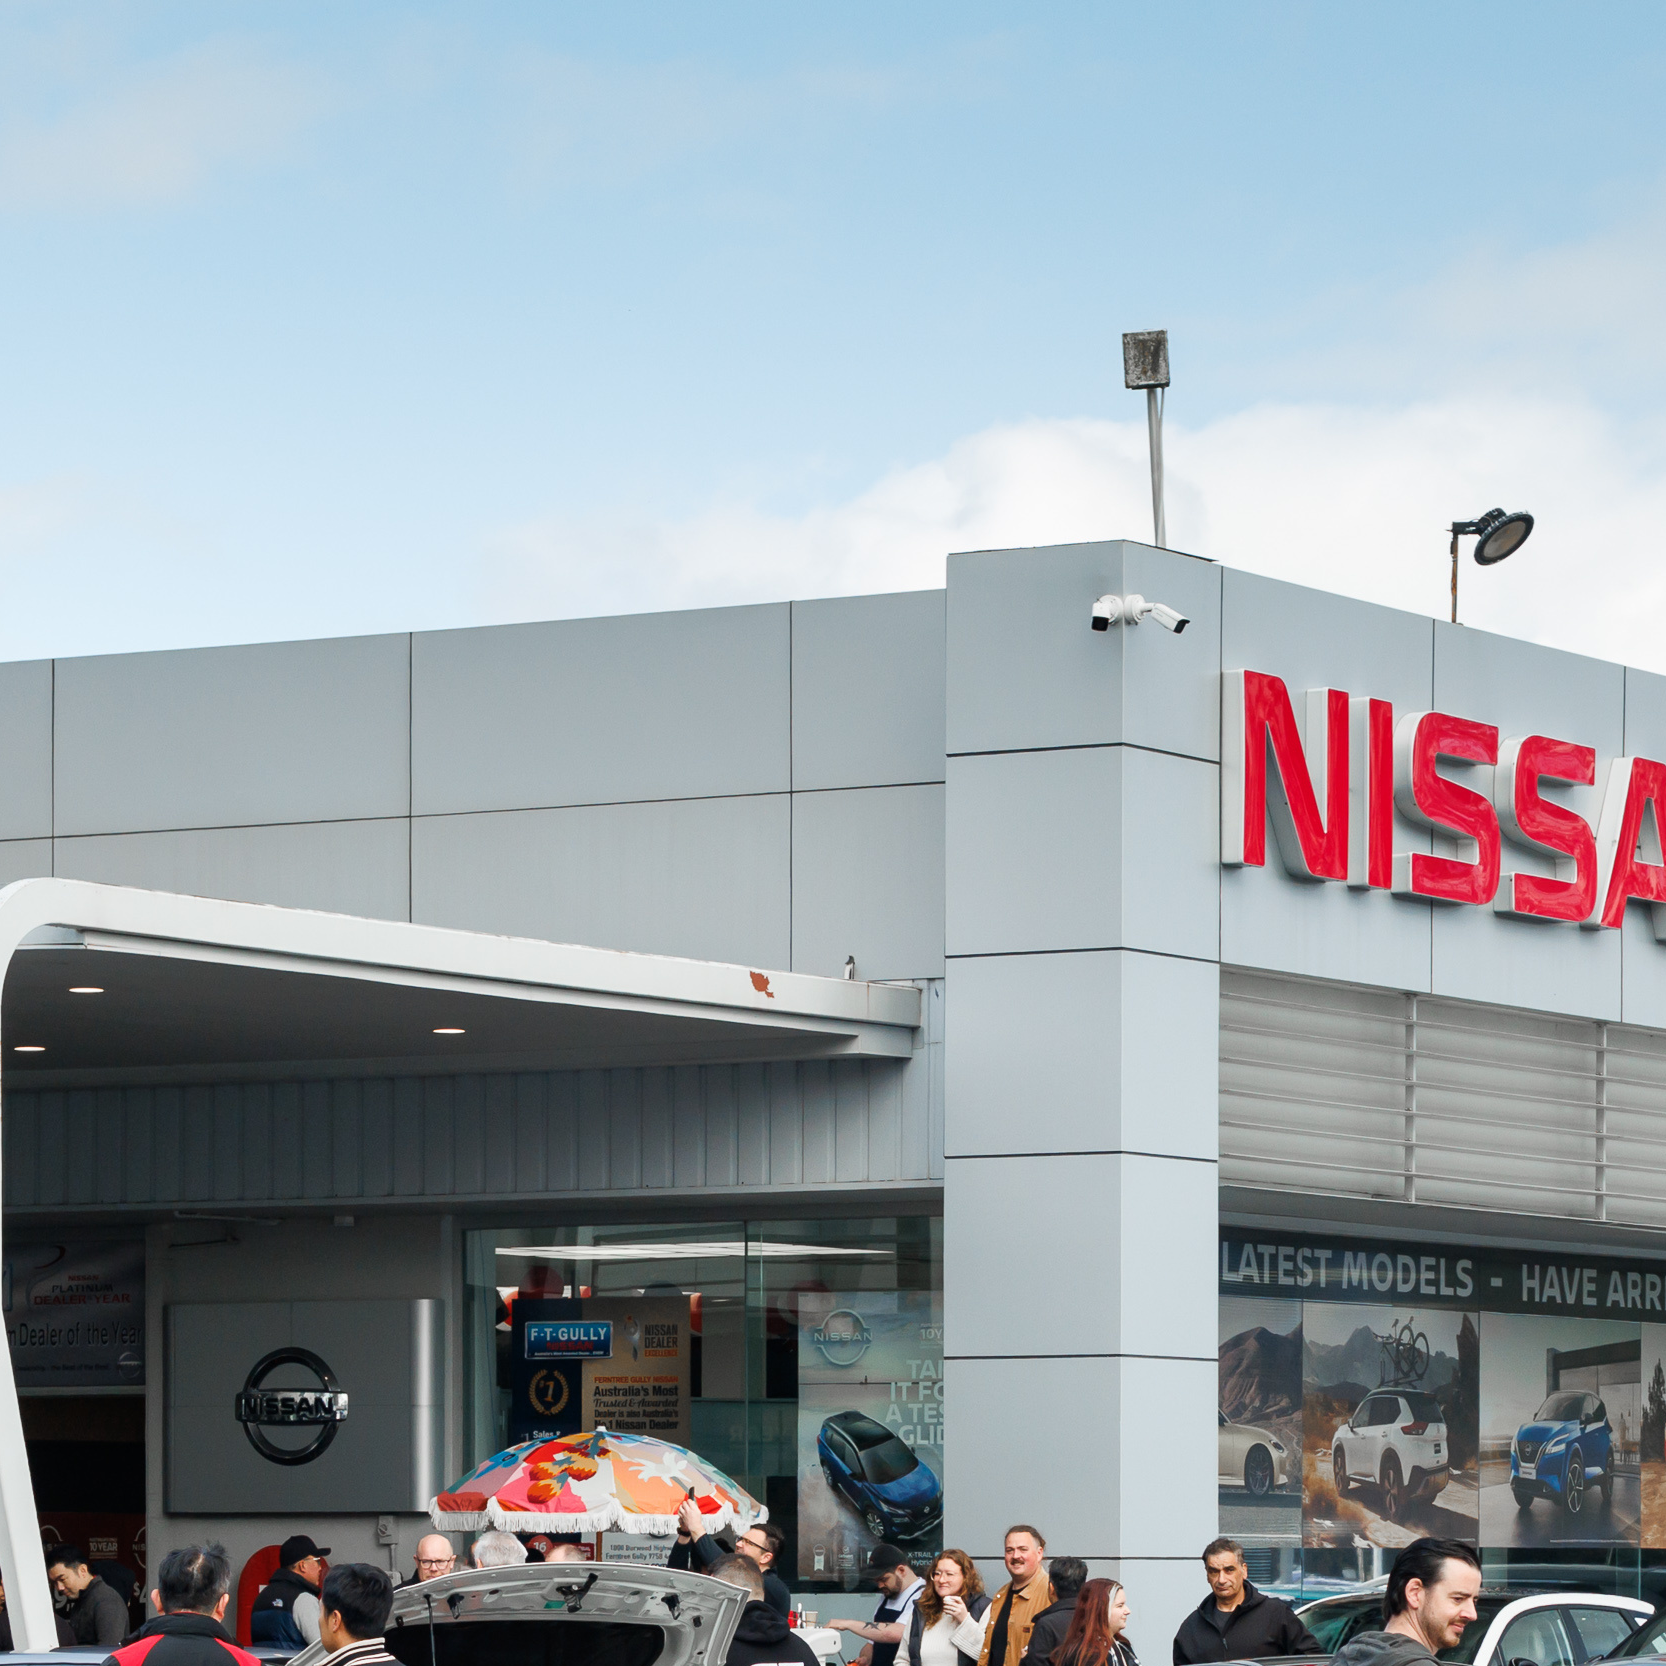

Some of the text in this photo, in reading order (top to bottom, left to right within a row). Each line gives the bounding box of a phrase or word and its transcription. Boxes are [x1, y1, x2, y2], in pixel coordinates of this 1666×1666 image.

[1221, 1241, 1333, 1288] LATEST
[1341, 1251, 1473, 1298] MODELS
[1522, 1263, 1598, 1306] HAVE
[19, 1323, 62, 1347] Dealer
[68, 1321, 81, 1346] of
[87, 1322, 108, 1345] the
[111, 1321, 142, 1346] Year
[530, 1327, 607, 1341] F-T-GULLY
[645, 1324, 678, 1336] NISSAN
[645, 1337, 678, 1349] DEALER
[814, 1332, 873, 1342] NISSAN
[594, 1376, 629, 1384] FERNTREE
[630, 1376, 651, 1384] GULLY
[594, 1386, 678, 1397] Australia's Most
[889, 1382, 912, 1402] IT
[242, 1396, 333, 1418] NISSAN
[593, 1398, 627, 1408] Trusted
[594, 1409, 616, 1418] Dealer
[618, 1409, 624, 1418] is
[626, 1409, 641, 1418] also
[885, 1403, 903, 1424] A
[615, 1419, 646, 1430] Nissan
[649, 1419, 679, 1430] Dealer
[533, 1541, 547, 1552] 16
